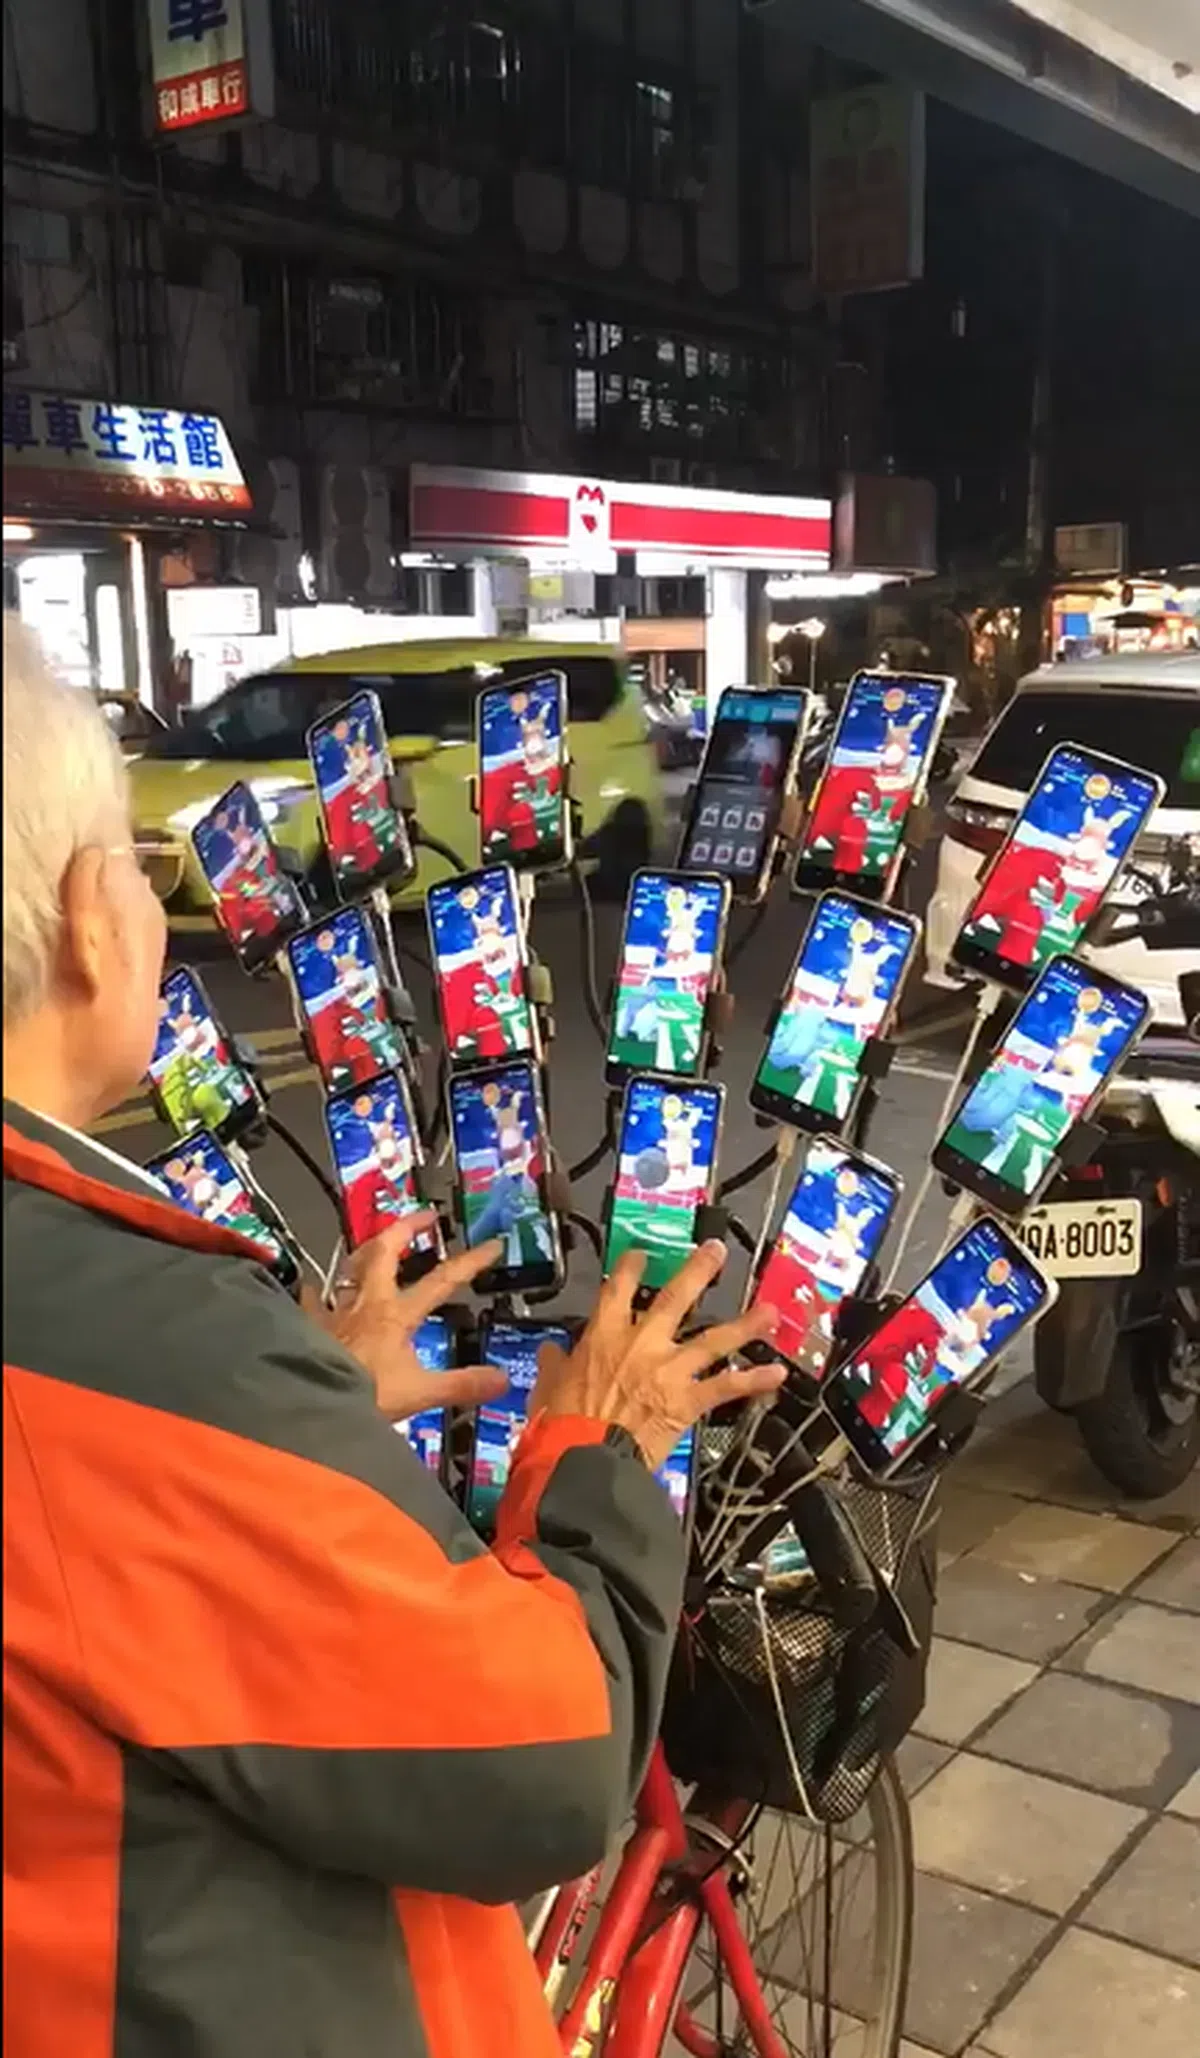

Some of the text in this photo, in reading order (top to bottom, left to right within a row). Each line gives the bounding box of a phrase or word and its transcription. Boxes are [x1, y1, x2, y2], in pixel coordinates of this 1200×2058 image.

[3, 393, 224, 469] 單車生活館
